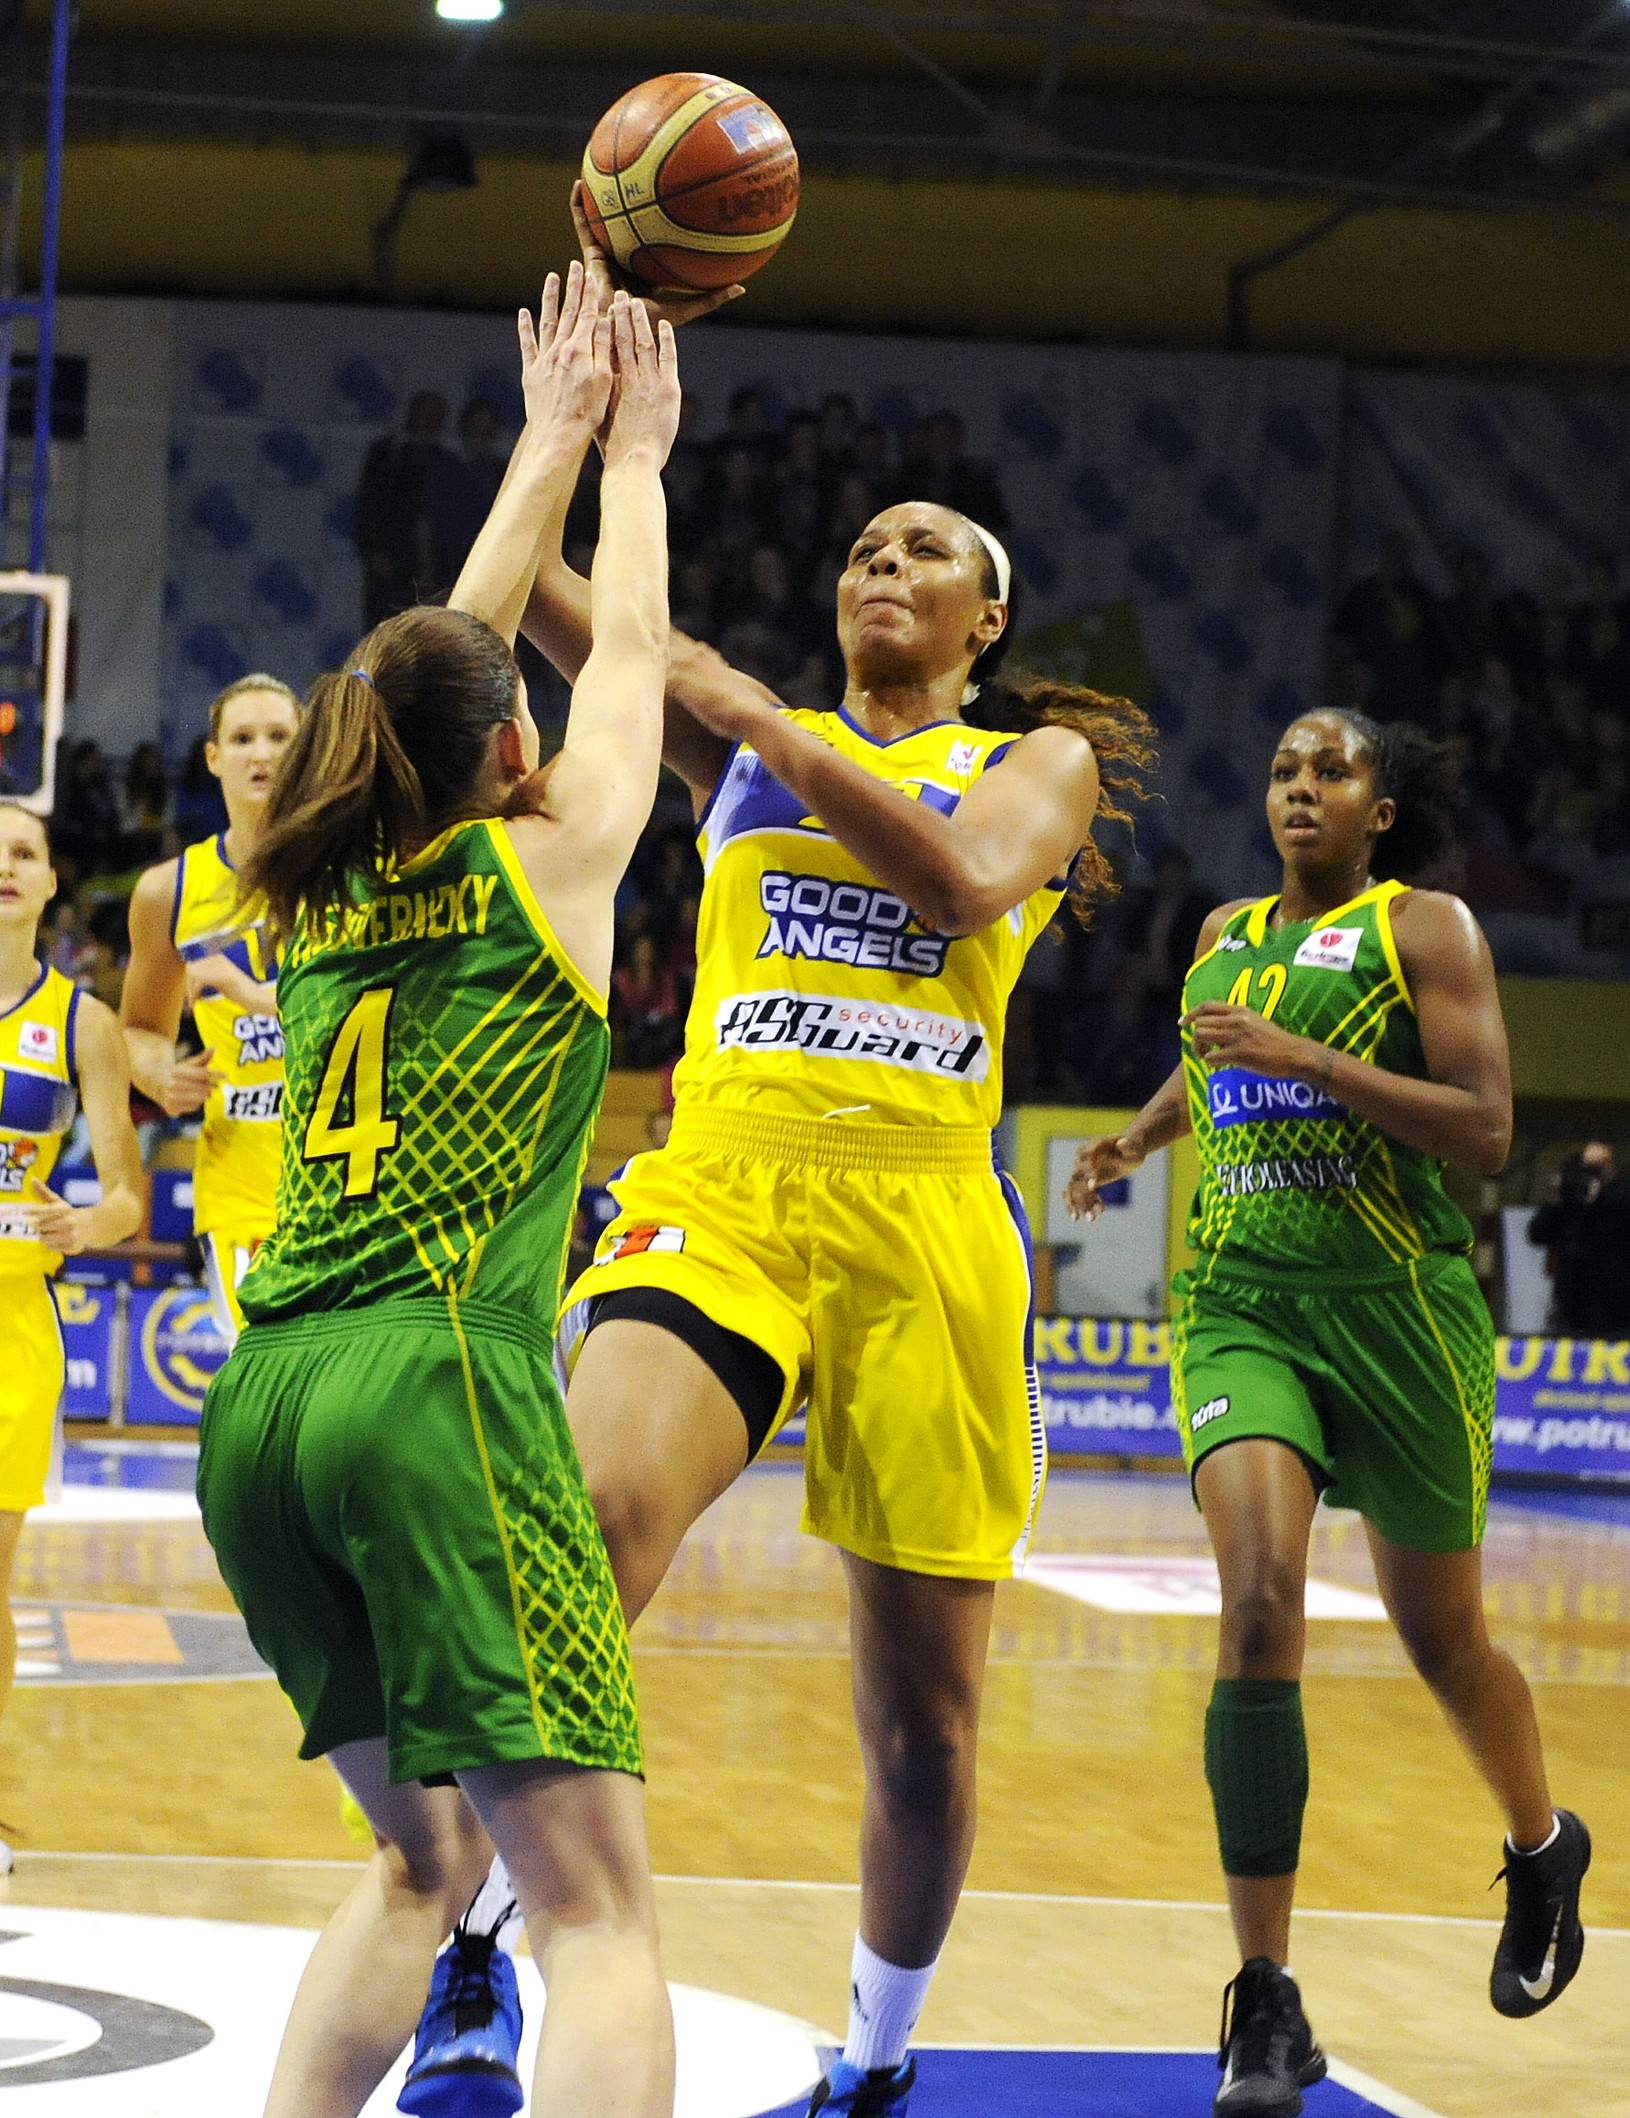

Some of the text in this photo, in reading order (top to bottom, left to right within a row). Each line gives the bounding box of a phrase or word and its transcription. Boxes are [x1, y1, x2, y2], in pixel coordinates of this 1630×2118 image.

[761, 874, 908, 930] GOOD
[757, 917, 944, 974] ANGELS
[839, 1008, 963, 1045] security
[302, 984, 400, 1199] 4
